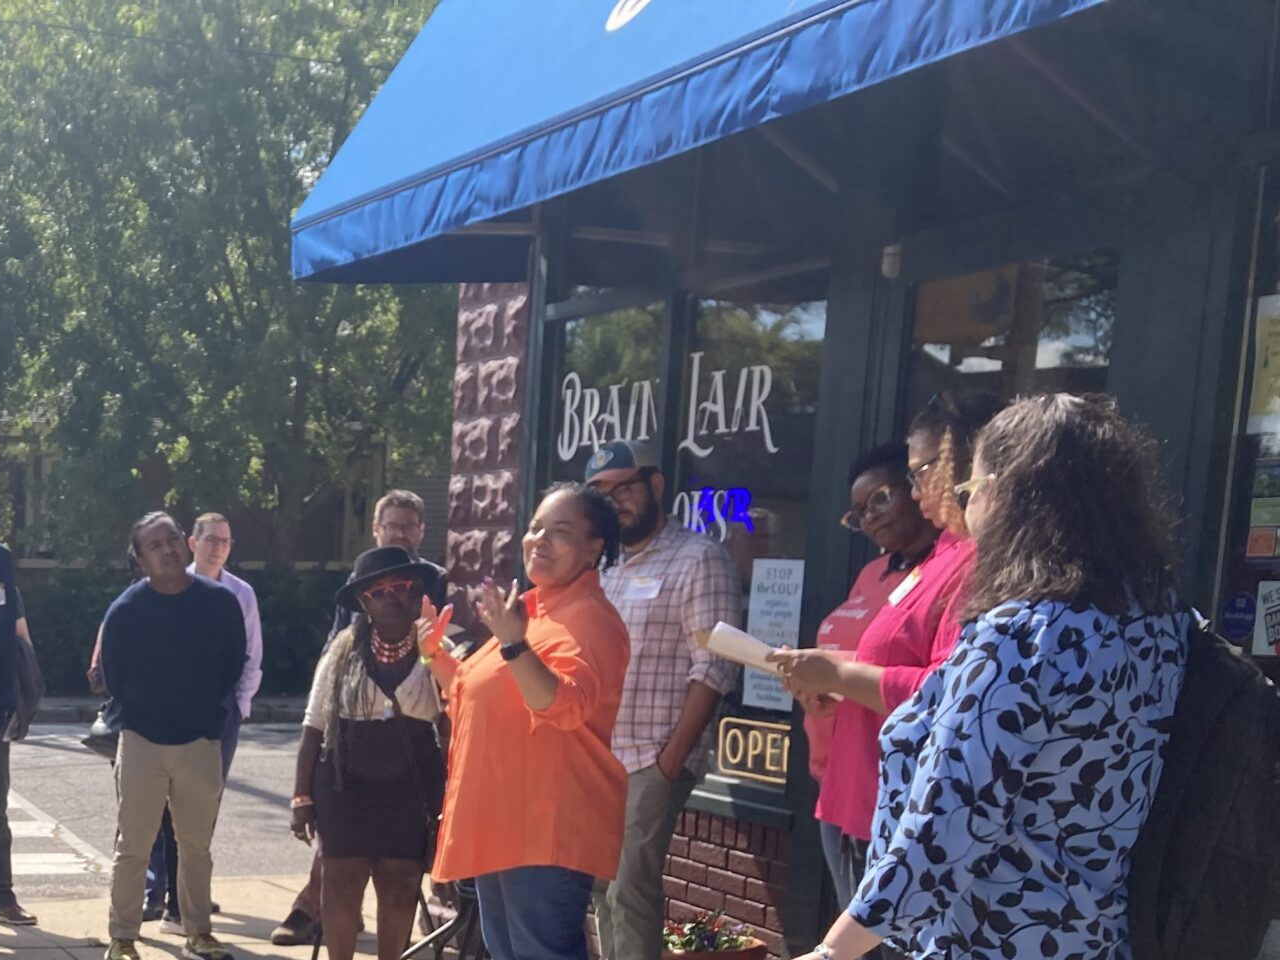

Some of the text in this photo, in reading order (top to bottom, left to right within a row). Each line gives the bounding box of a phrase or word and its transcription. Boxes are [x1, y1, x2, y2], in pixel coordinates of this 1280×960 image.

[557, 351, 780, 461] BRAIN LAIR
[766, 567, 792, 580] STOP
[771, 583, 800, 596] COUP
